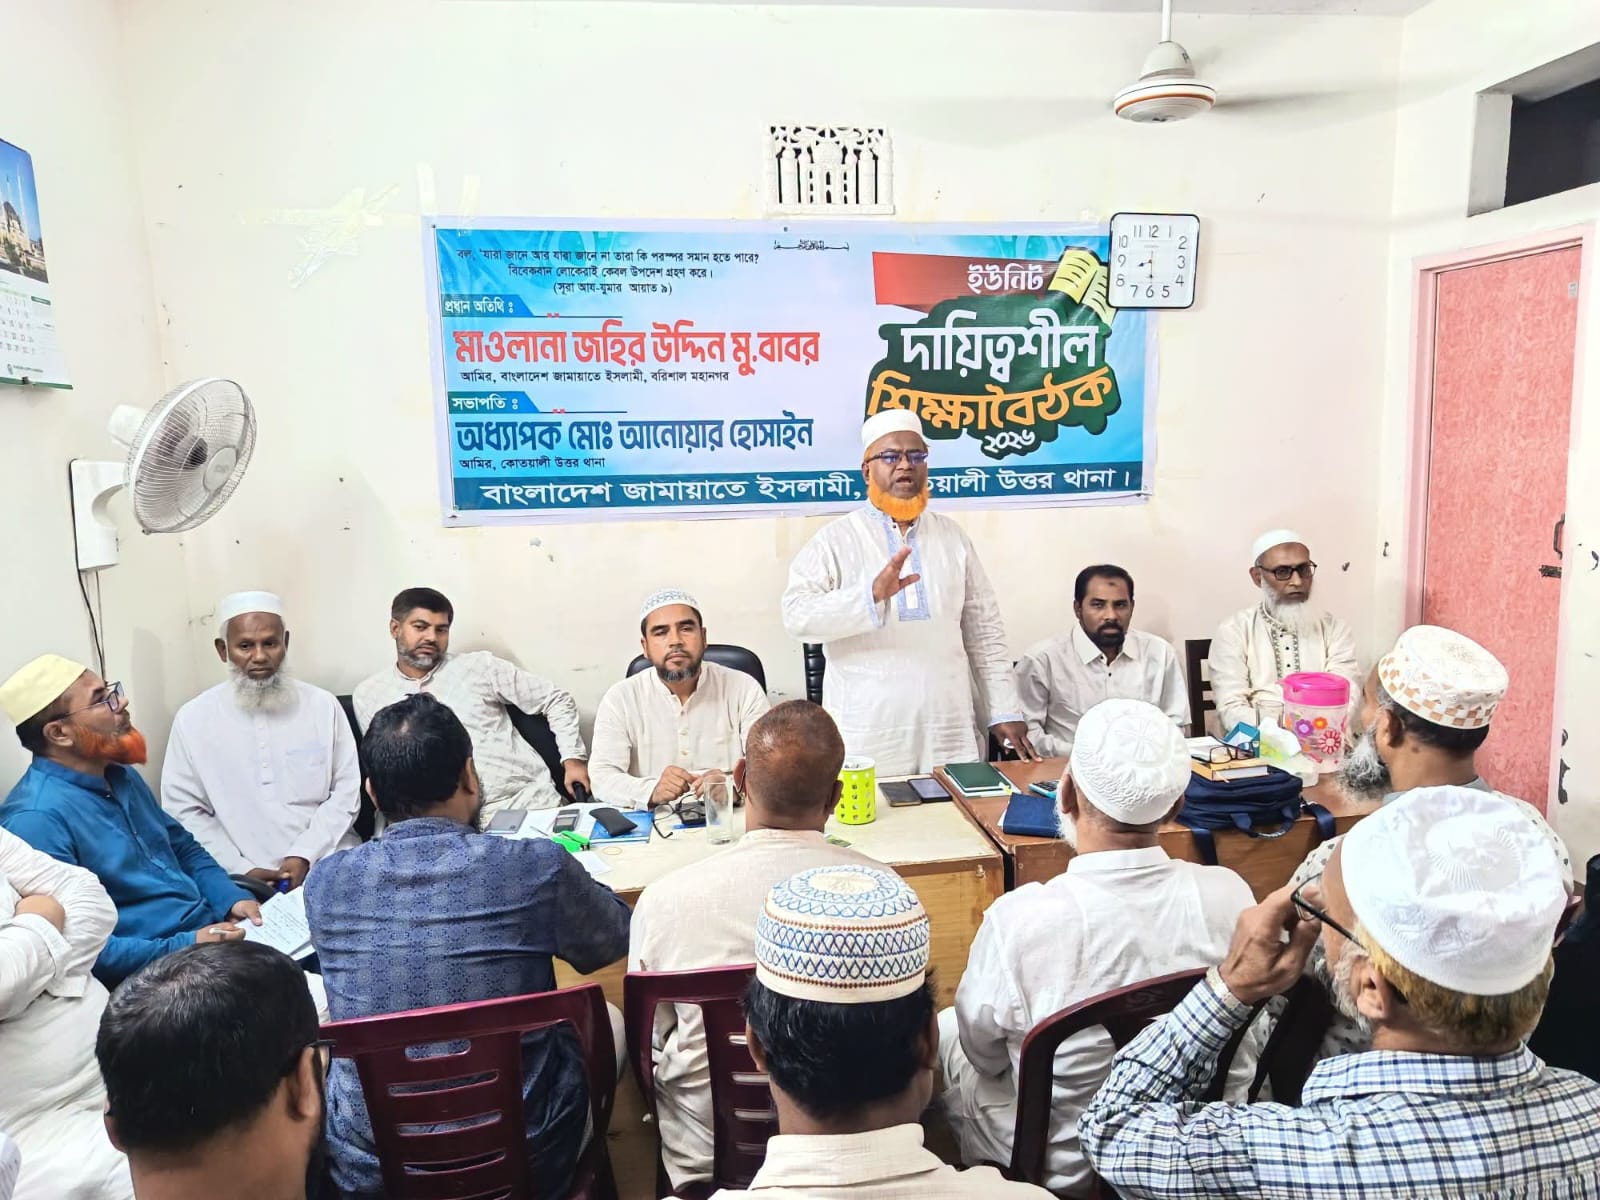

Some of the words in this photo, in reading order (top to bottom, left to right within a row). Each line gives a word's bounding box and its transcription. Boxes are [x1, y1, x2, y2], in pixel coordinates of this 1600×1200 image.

[1133, 225, 1142, 238] 11
[1149, 225, 1159, 238] 12
[1118, 235, 1128, 248] 10
[1178, 236, 1188, 250] 2
[505, 250, 527, 260] জানে
[532, 250, 549, 260] আর
[553, 250, 571, 261] যারা
[576, 250, 597, 261] জানে
[601, 251, 610, 261] না
[614, 251, 633, 262] তারা
[637, 248, 647, 262] কি
[651, 252, 683, 263] পরস্পর
[687, 252, 709, 263] সমান
[713, 252, 730, 264] হতে
[734, 253, 759, 264] পারে?
[1117, 254, 1126, 267] 9
[1177, 255, 1186, 269] 3
[508, 263, 552, 276] বিবেকবান
[556, 264, 598, 277] লোকেরাই
[602, 266, 627, 277] কেবল
[630, 265, 662, 278] উপদেশ
[666, 267, 685, 279] গ্রহণ
[967, 262, 1044, 294] ইউনিট
[1115, 273, 1125, 287] 8
[1175, 274, 1185, 288] 4
[553, 282, 574, 295] (সূরা
[1130, 284, 1138, 298] 7
[1145, 284, 1154, 298] 6
[1161, 285, 1170, 298] 5
[444, 299, 470, 313] প্রধান
[472, 297, 504, 313] অতিথি
[453, 331, 567, 363] মাওলানা
[572, 319, 646, 367] জহির
[651, 319, 726, 363] উদ্দিন
[901, 308, 1099, 382] দায়িত্বশীল
[461, 370, 496, 384] আমির,
[500, 371, 549, 383] বাংলাদেশ
[553, 371, 601, 383] জামায়াতে
[605, 369, 648, 383] ইসলামী,
[651, 369, 687, 382] বরিশাল
[691, 371, 729, 382] মহানগর
[452, 394, 506, 411] সভাপতি
[455, 421, 562, 451] অধ্যাপক
[568, 420, 613, 450] মোঃ
[618, 419, 724, 453] আনোয়ার
[730, 410, 813, 450] হোসাইন
[984, 429, 1036, 453] ২০২৬
[459, 456, 496, 471] আমির,
[501, 455, 550, 469] কোতয়ালী
[554, 456, 579, 469] উত্তর
[583, 456, 606, 469] থানা
[480, 480, 613, 506] বাংলাদেশ
[619, 479, 749, 502] জামায়াতে
[755, 472, 861, 500] ইসলামী,
[928, 468, 990, 493] য়ালী
[996, 467, 1055, 490] উত্তর
[1063, 468, 1117, 488] থানা
